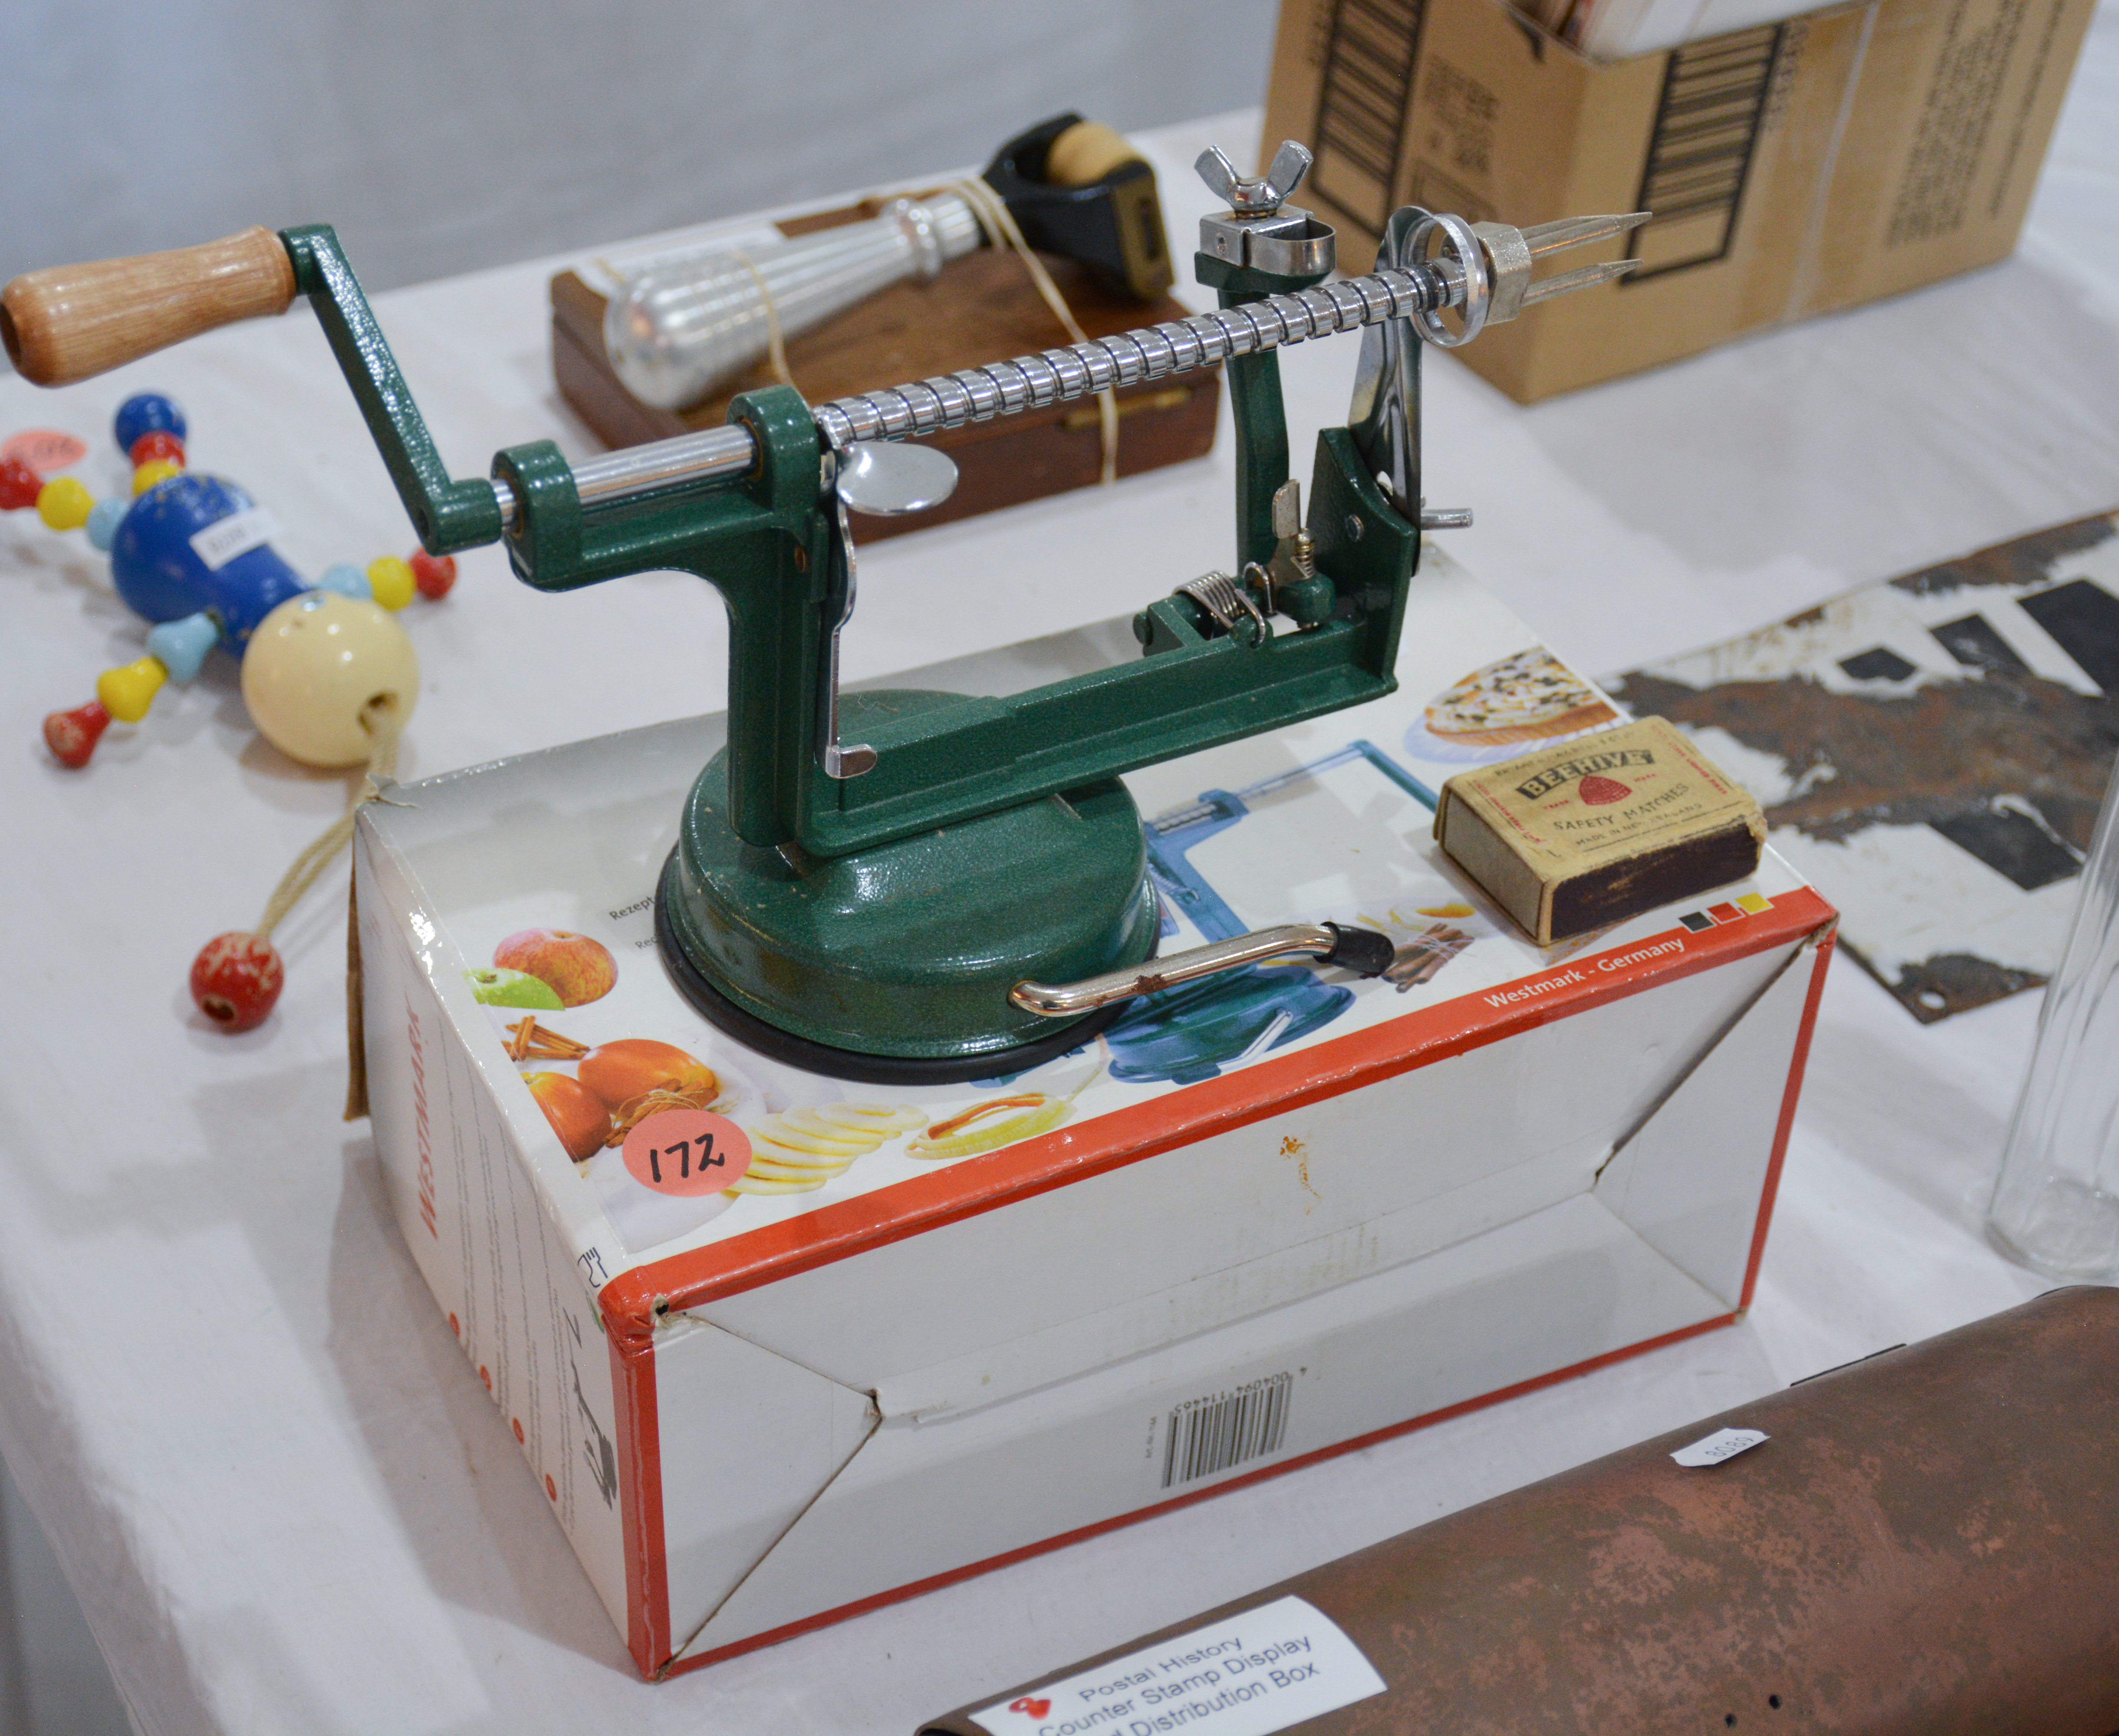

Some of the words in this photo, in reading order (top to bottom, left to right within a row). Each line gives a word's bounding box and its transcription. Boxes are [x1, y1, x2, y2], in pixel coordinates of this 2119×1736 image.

[1520, 750, 1651, 798] BEEHIVE
[1553, 815, 1615, 831] SAFETY
[1623, 783, 1690, 820] MATCHES
[1575, 832, 1606, 845] MADE
[1484, 969, 1586, 1008] Westmark
[1597, 938, 1685, 972] Germany
[650, 1133, 725, 1183] 172
[1705, 1437, 1754, 1457] 8089
[1039, 1699, 1136, 1736] Counter
[1141, 1670, 1221, 1705] Stamp
[1222, 1636, 1312, 1675] Display
[1078, 1667, 1157, 1702] Postal
[1158, 1637, 1243, 1673] History
[1129, 1681, 1268, 1736] Distribution
[1268, 1662, 1321, 1689] Box
